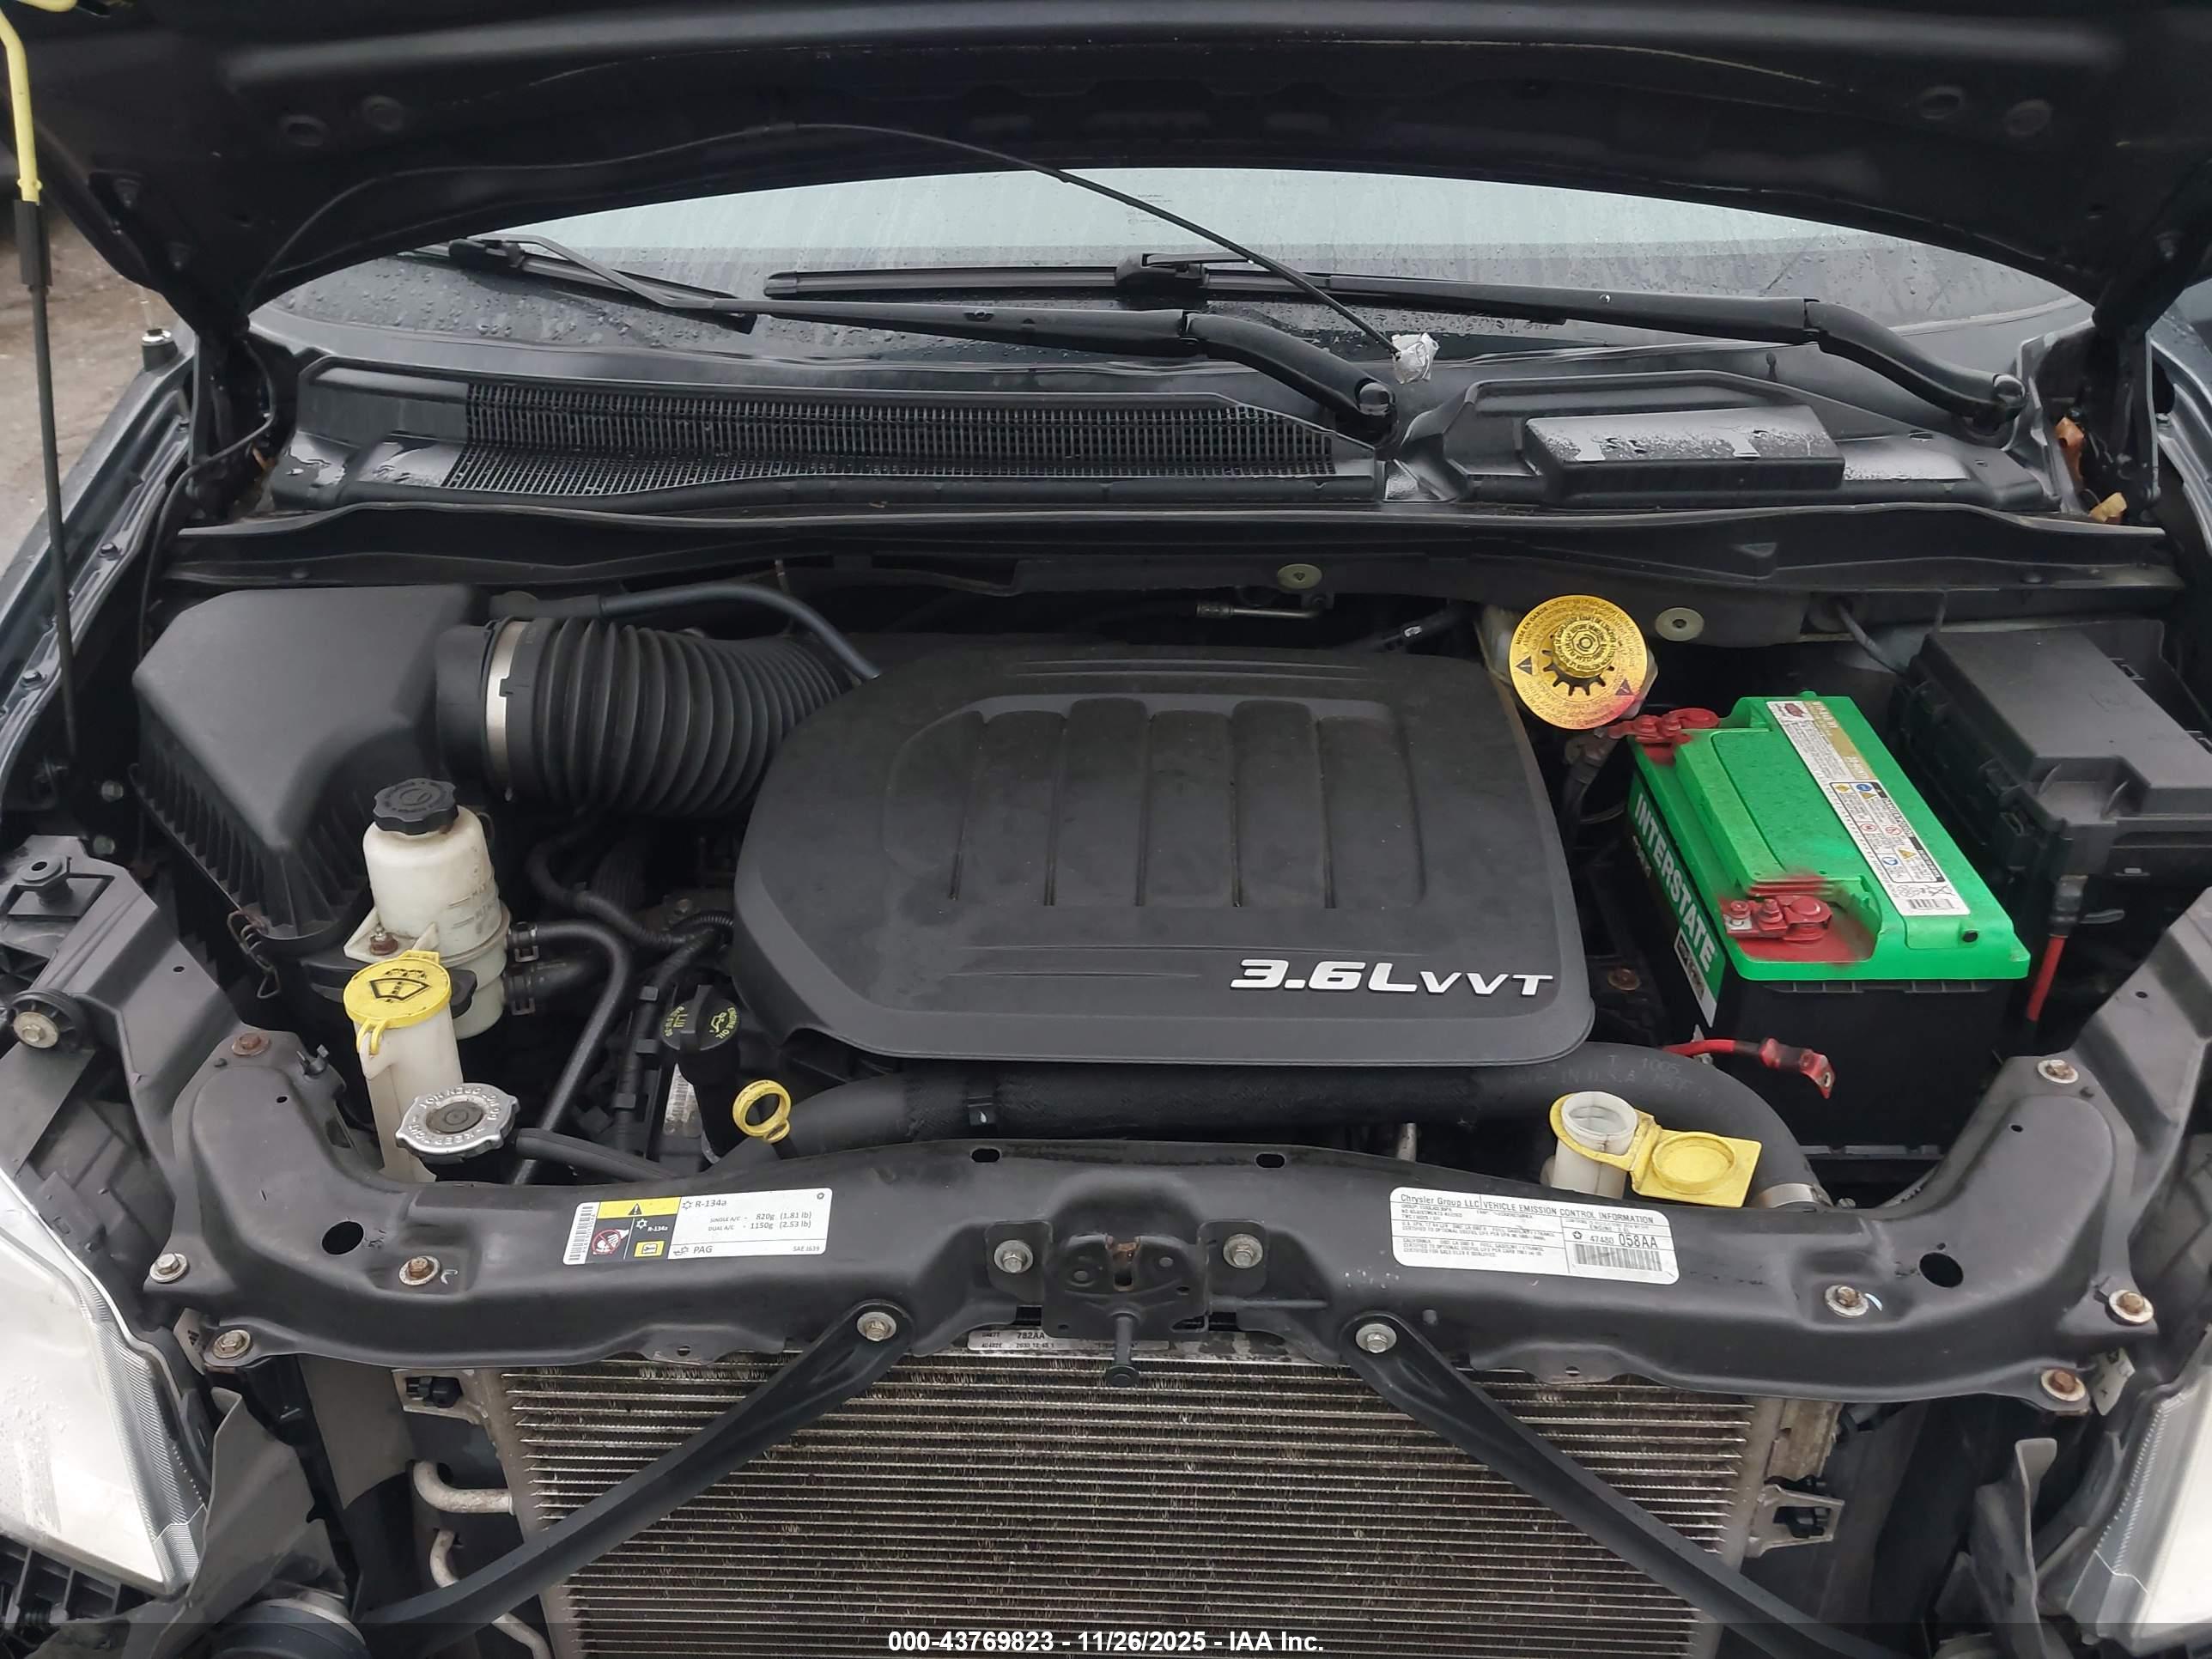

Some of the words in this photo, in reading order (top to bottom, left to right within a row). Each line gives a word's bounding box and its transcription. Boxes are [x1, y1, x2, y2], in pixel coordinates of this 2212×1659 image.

[1634, 793, 1716, 973] INTERSTATE
[715, 1029, 730, 1039] OIL
[695, 1199, 727, 1208] R-134a
[1401, 1194, 1435, 1204] Chrysler
[1437, 1197, 1462, 1207] Group
[1464, 1200, 1480, 1208] LLC
[756, 1212, 775, 1221] 820g
[800, 1211, 812, 1219] lb)
[1483, 1200, 1516, 1212] VEHICLE
[1518, 1203, 1557, 1215] EMISSION
[1559, 1208, 1597, 1219] CONTROL
[1598, 1212, 1654, 1224] INFORMATION
[779, 1220, 799, 1229] (2.53
[800, 1219, 812, 1229] lb)
[1618, 1232, 1659, 1249] 058AA
[693, 1245, 714, 1254] PAG
[1016, 1331, 1046, 1340] 782AA
